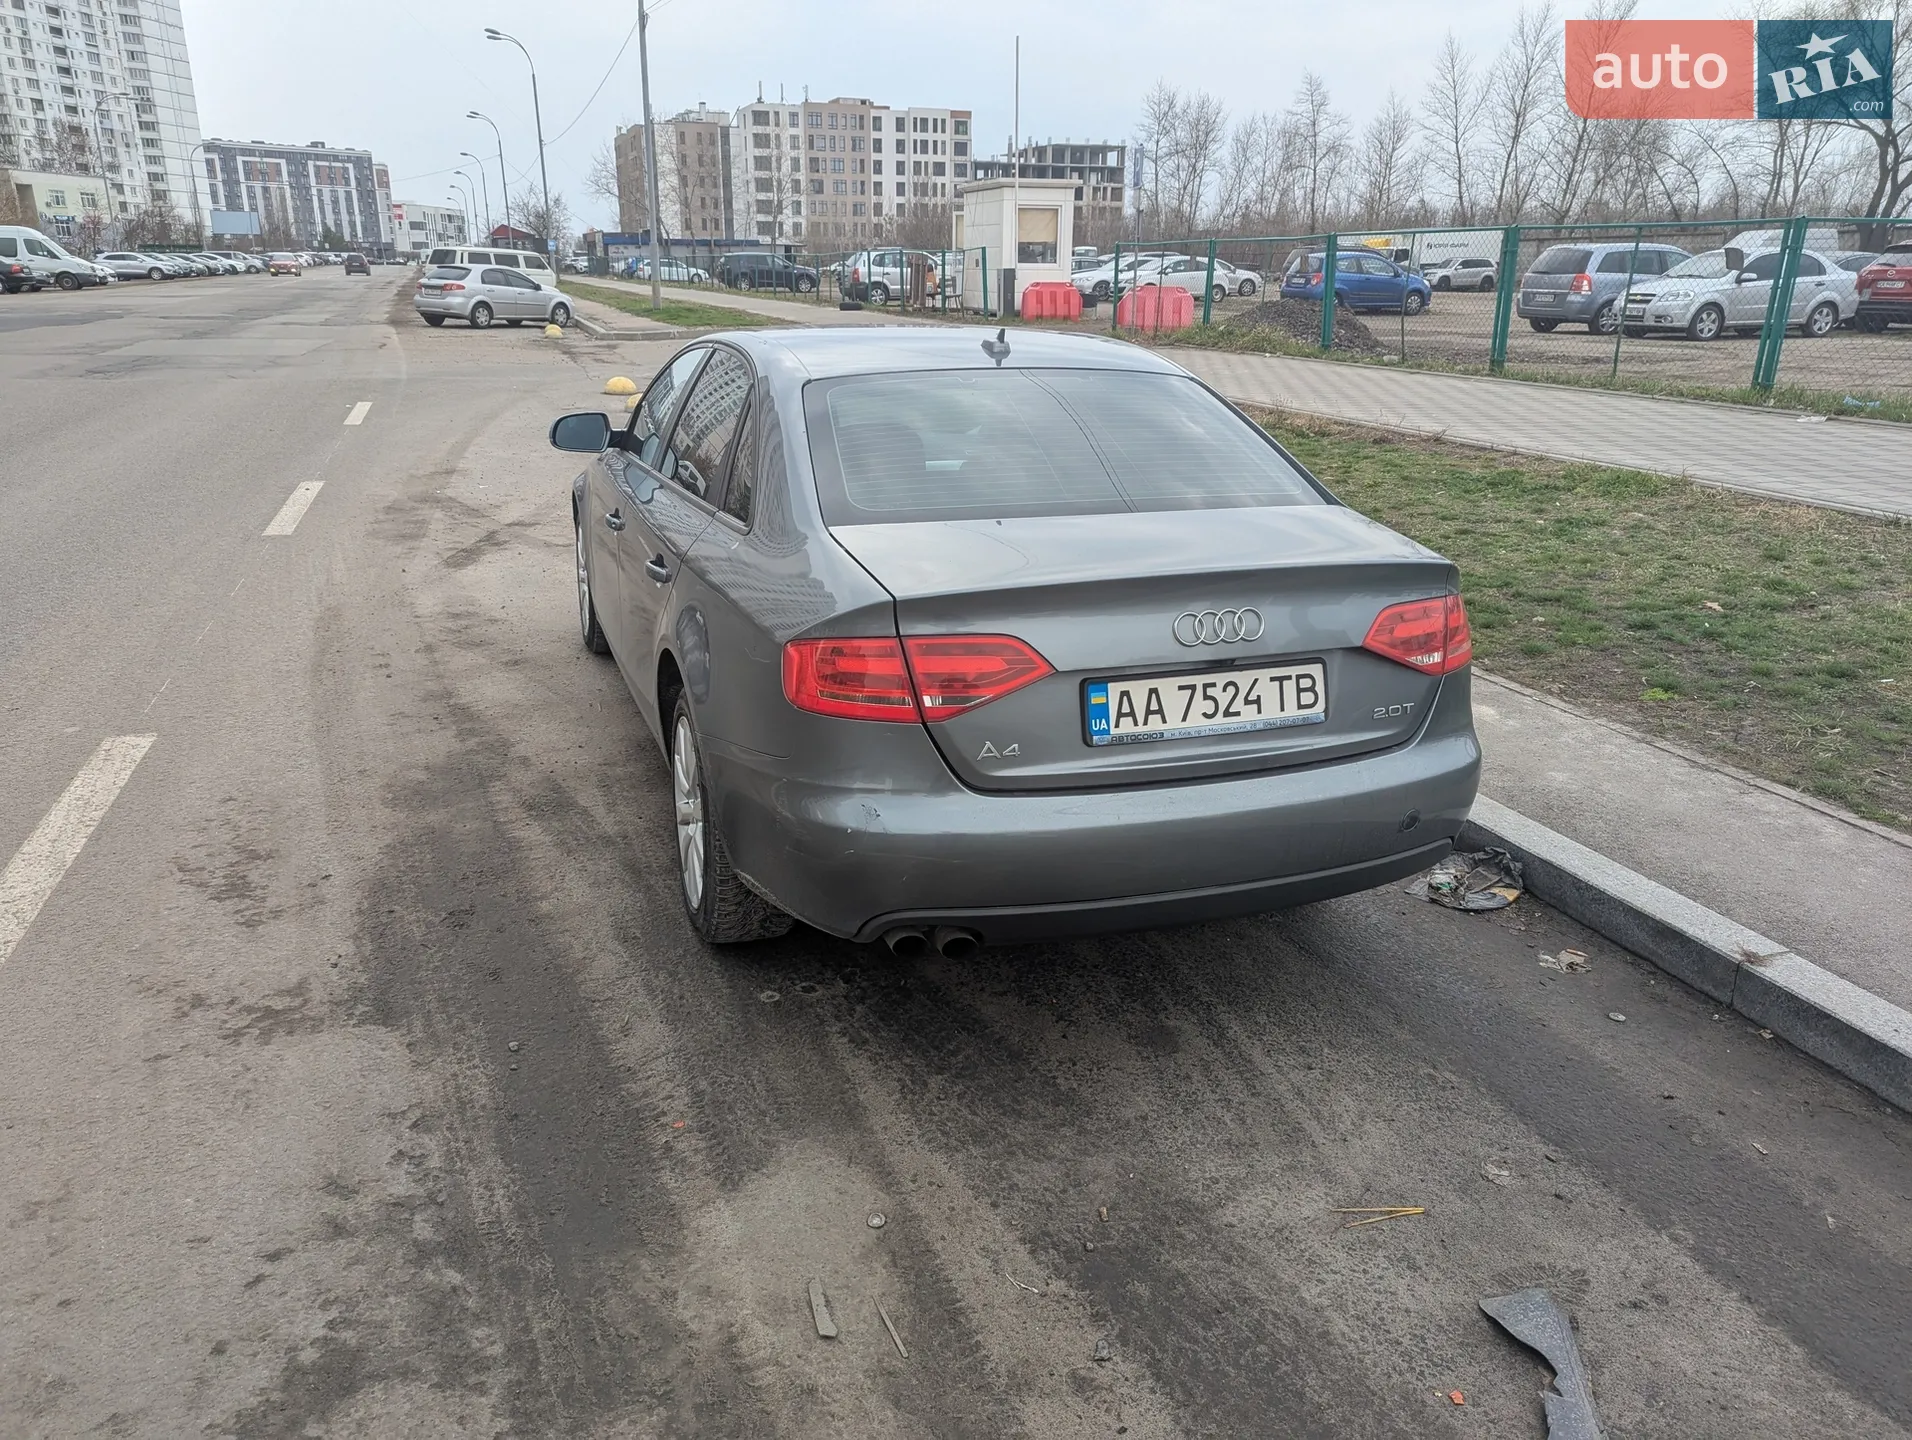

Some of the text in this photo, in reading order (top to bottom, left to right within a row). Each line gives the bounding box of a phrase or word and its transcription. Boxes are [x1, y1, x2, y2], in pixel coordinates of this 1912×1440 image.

[1114, 673, 1319, 728] AA 7524 TB
[1373, 702, 1415, 719] 2.0T
[1092, 718, 1108, 731] UA
[1111, 731, 1165, 744] АВТОСОЮЗ
[976, 740, 1021, 761] A4
